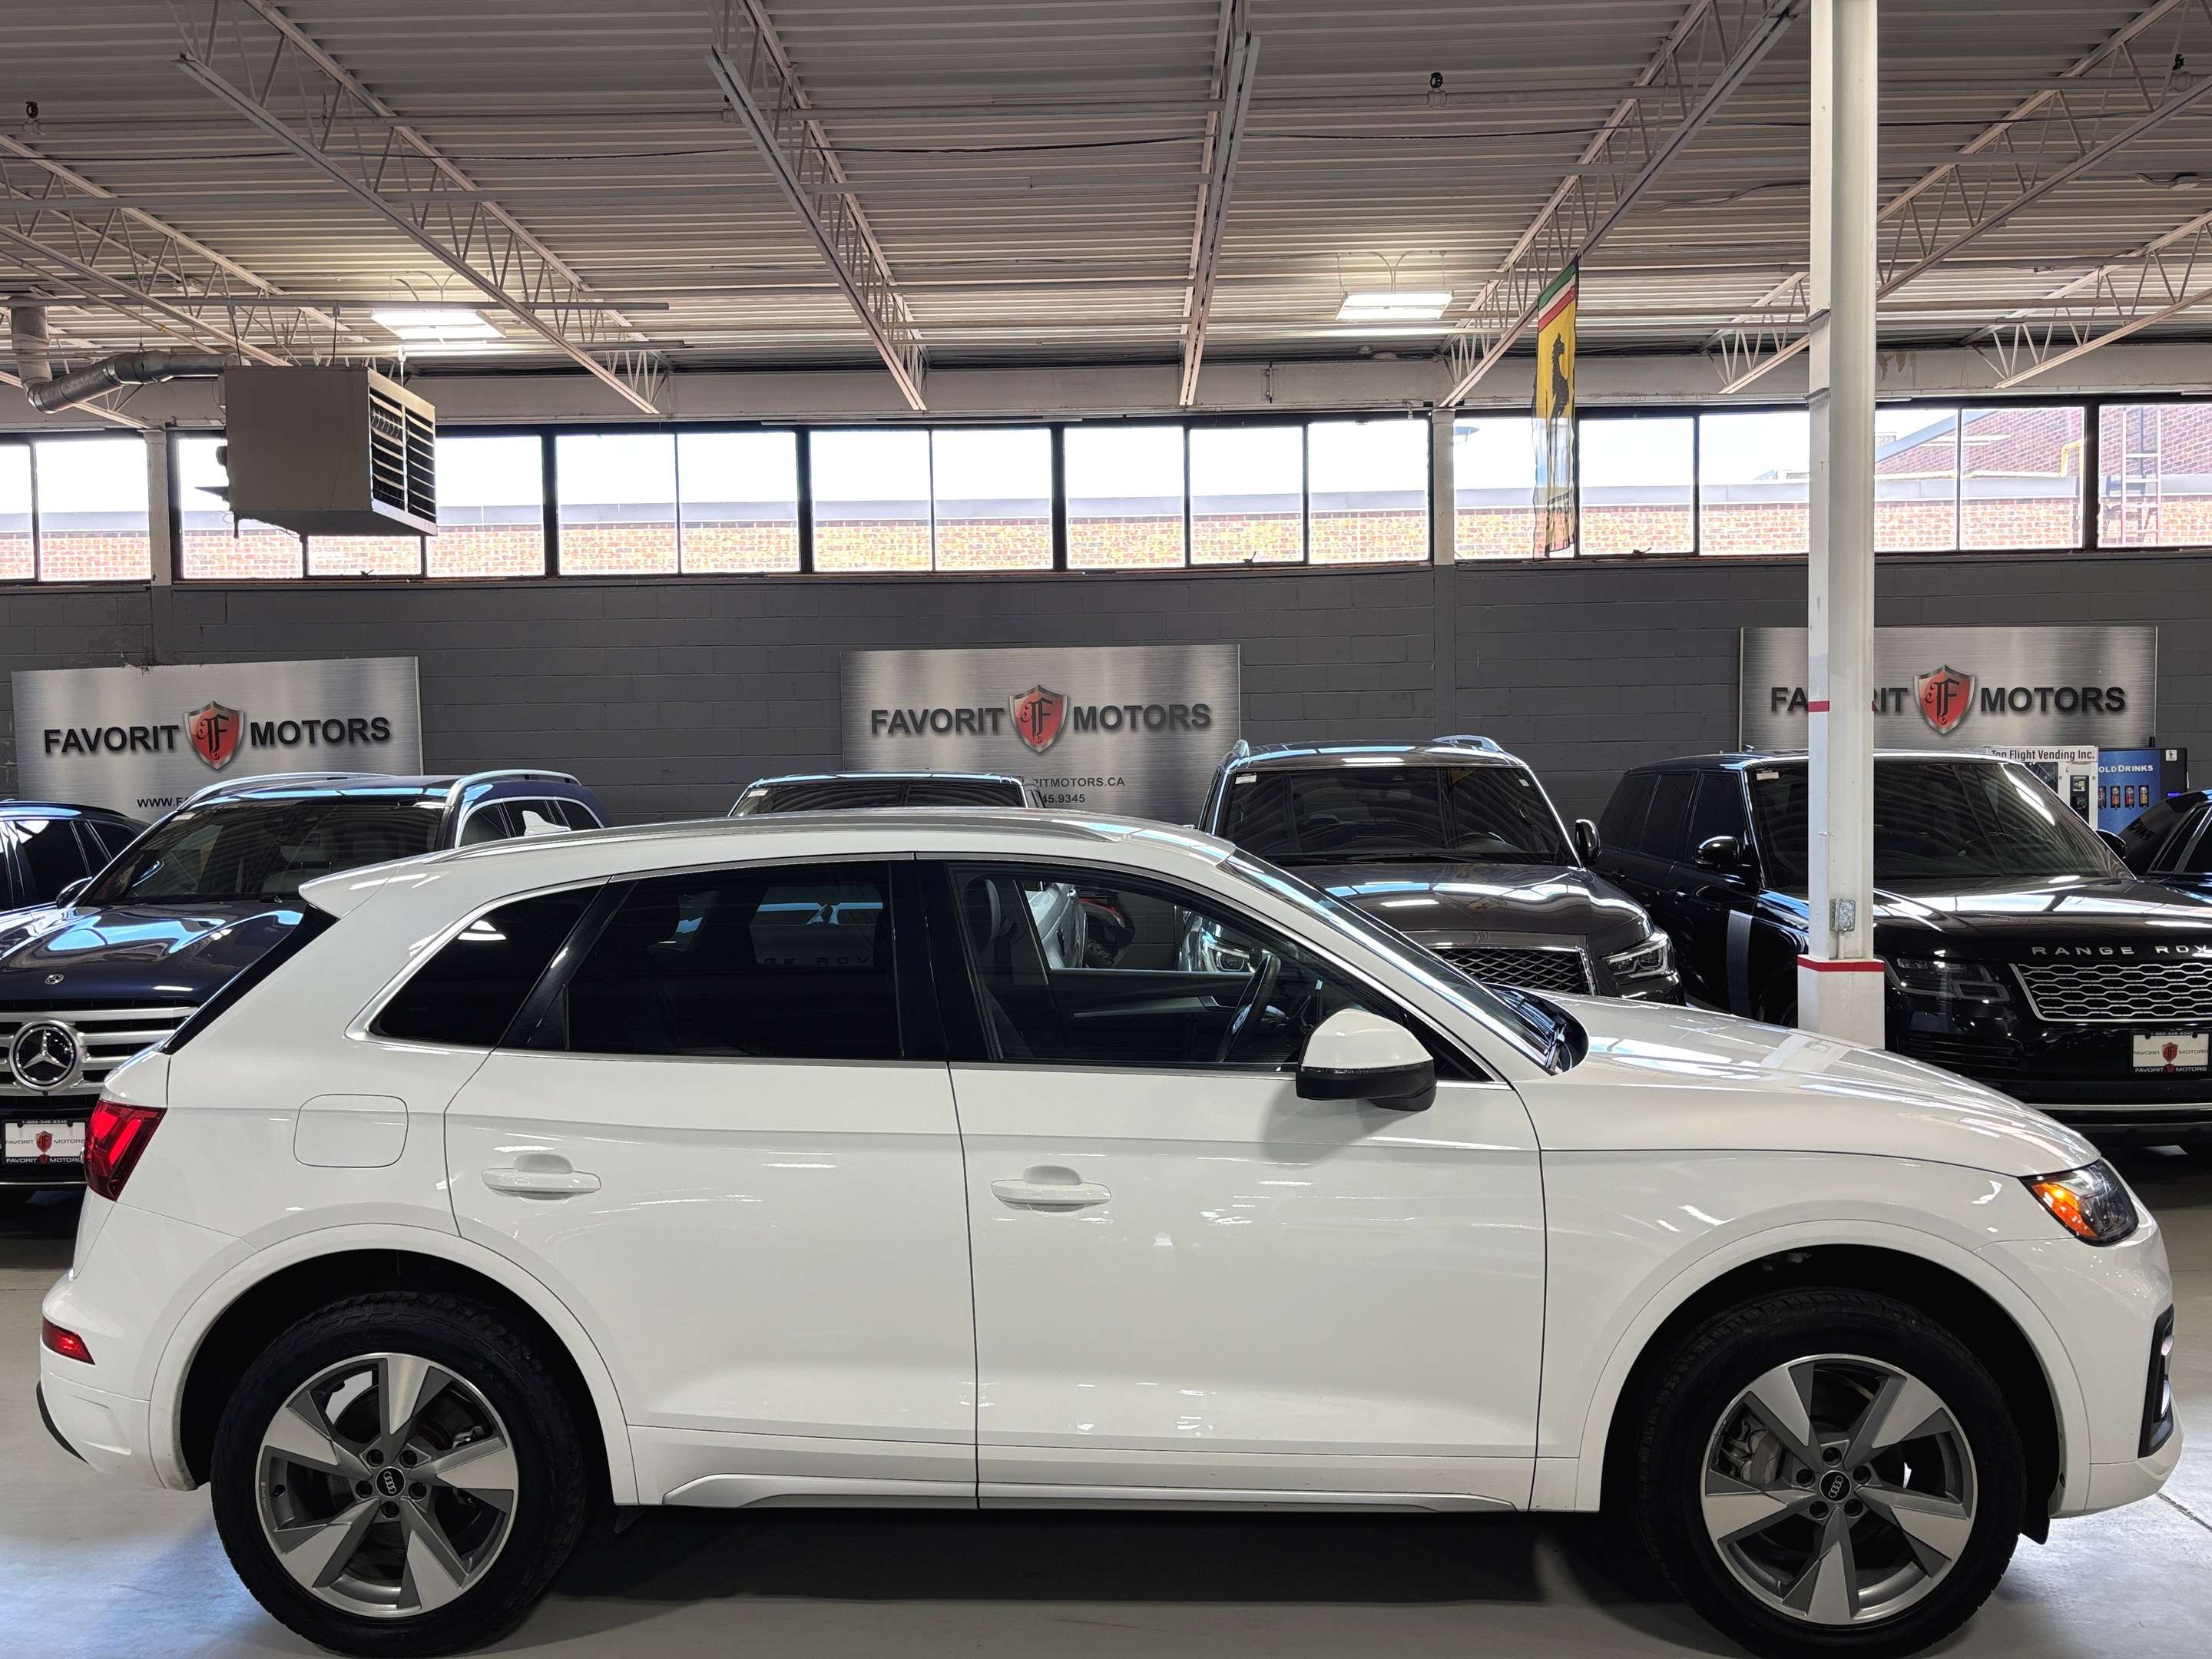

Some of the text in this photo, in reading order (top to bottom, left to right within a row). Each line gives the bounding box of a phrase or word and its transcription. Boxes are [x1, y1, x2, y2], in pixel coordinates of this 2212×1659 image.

[1981, 687, 2126, 713] MOTORS
[871, 707, 1004, 733] FAVORIT
[1074, 703, 1211, 730] MOTORS
[44, 724, 179, 753] FAVORIT
[250, 717, 390, 747] MOTORS
[2009, 750, 2035, 761] Flight
[2038, 750, 2075, 761] Vending
[2078, 750, 2094, 759] Inc.
[2118, 764, 2154, 773] DRINKS
[2032, 946, 2134, 955] RANGE
